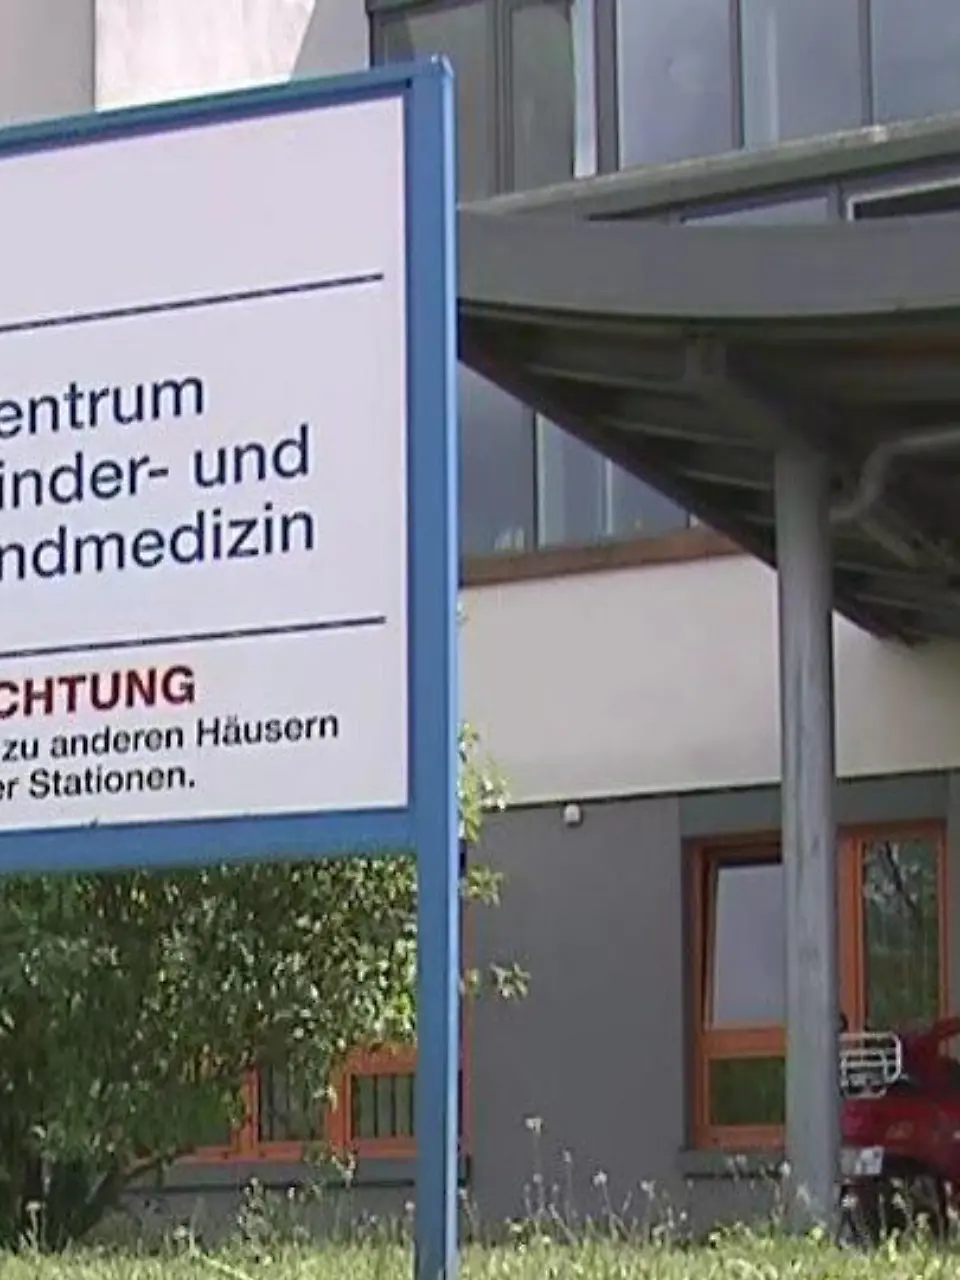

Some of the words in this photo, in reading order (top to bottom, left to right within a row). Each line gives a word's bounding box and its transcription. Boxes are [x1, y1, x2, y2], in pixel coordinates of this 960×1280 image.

[194, 423, 309, 489] und
[1, 739, 39, 763] zu
[49, 725, 184, 759] anderen
[196, 715, 339, 748] Häusern
[28, 765, 196, 800] Stationen.
